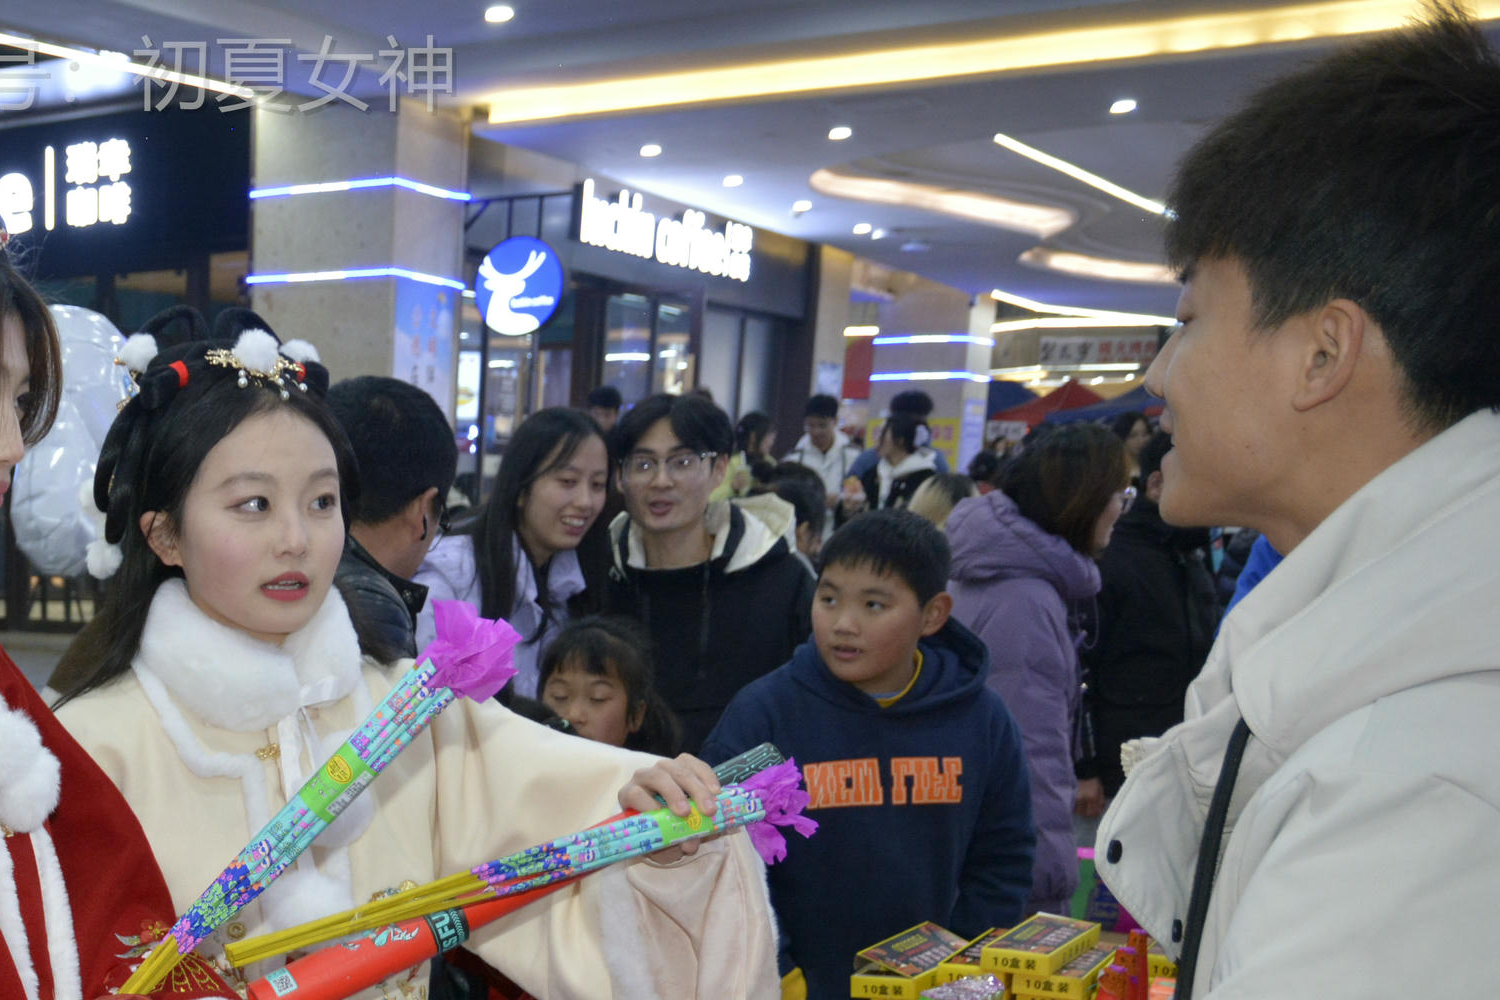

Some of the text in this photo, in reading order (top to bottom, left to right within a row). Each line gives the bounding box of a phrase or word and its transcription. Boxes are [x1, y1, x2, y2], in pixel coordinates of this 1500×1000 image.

[993, 957, 1037, 970] 10盒装
[862, 984, 903, 995] 10盒装
[1025, 979, 1069, 993] 10盒装
